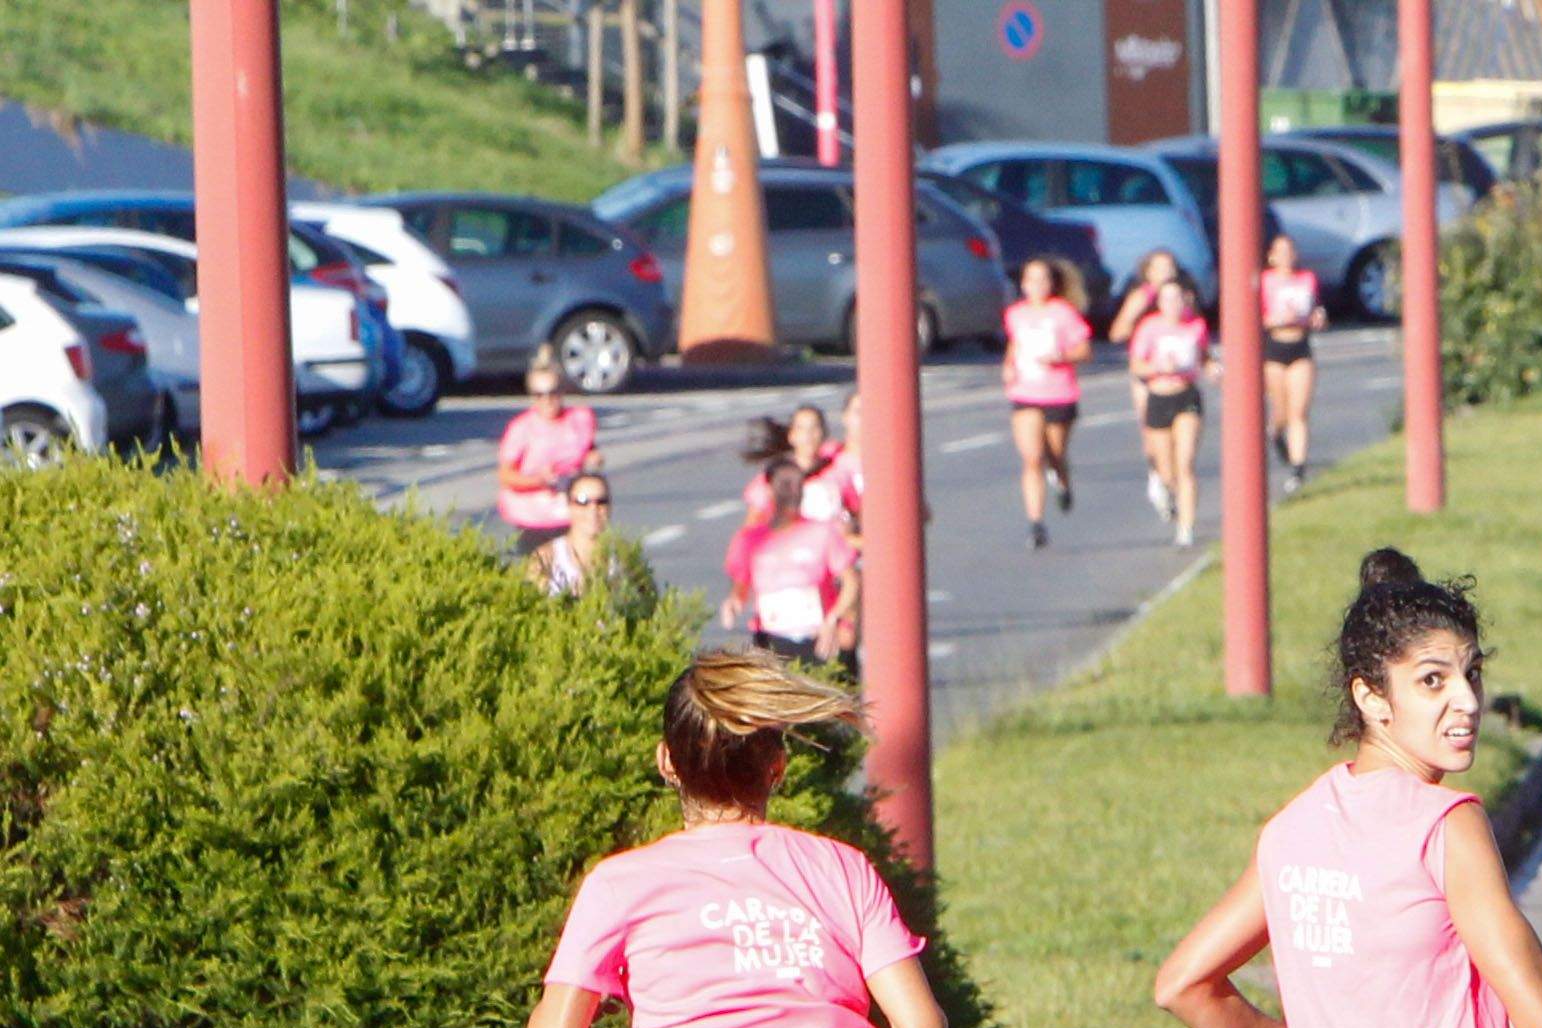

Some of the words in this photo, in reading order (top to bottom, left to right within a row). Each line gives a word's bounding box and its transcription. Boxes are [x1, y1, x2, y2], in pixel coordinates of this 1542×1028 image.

[1290, 893, 1320, 923] DE
[1326, 898, 1349, 927] LA
[732, 920, 773, 947] DE
[783, 919, 820, 945] LA
[734, 943, 824, 973] MUJER
